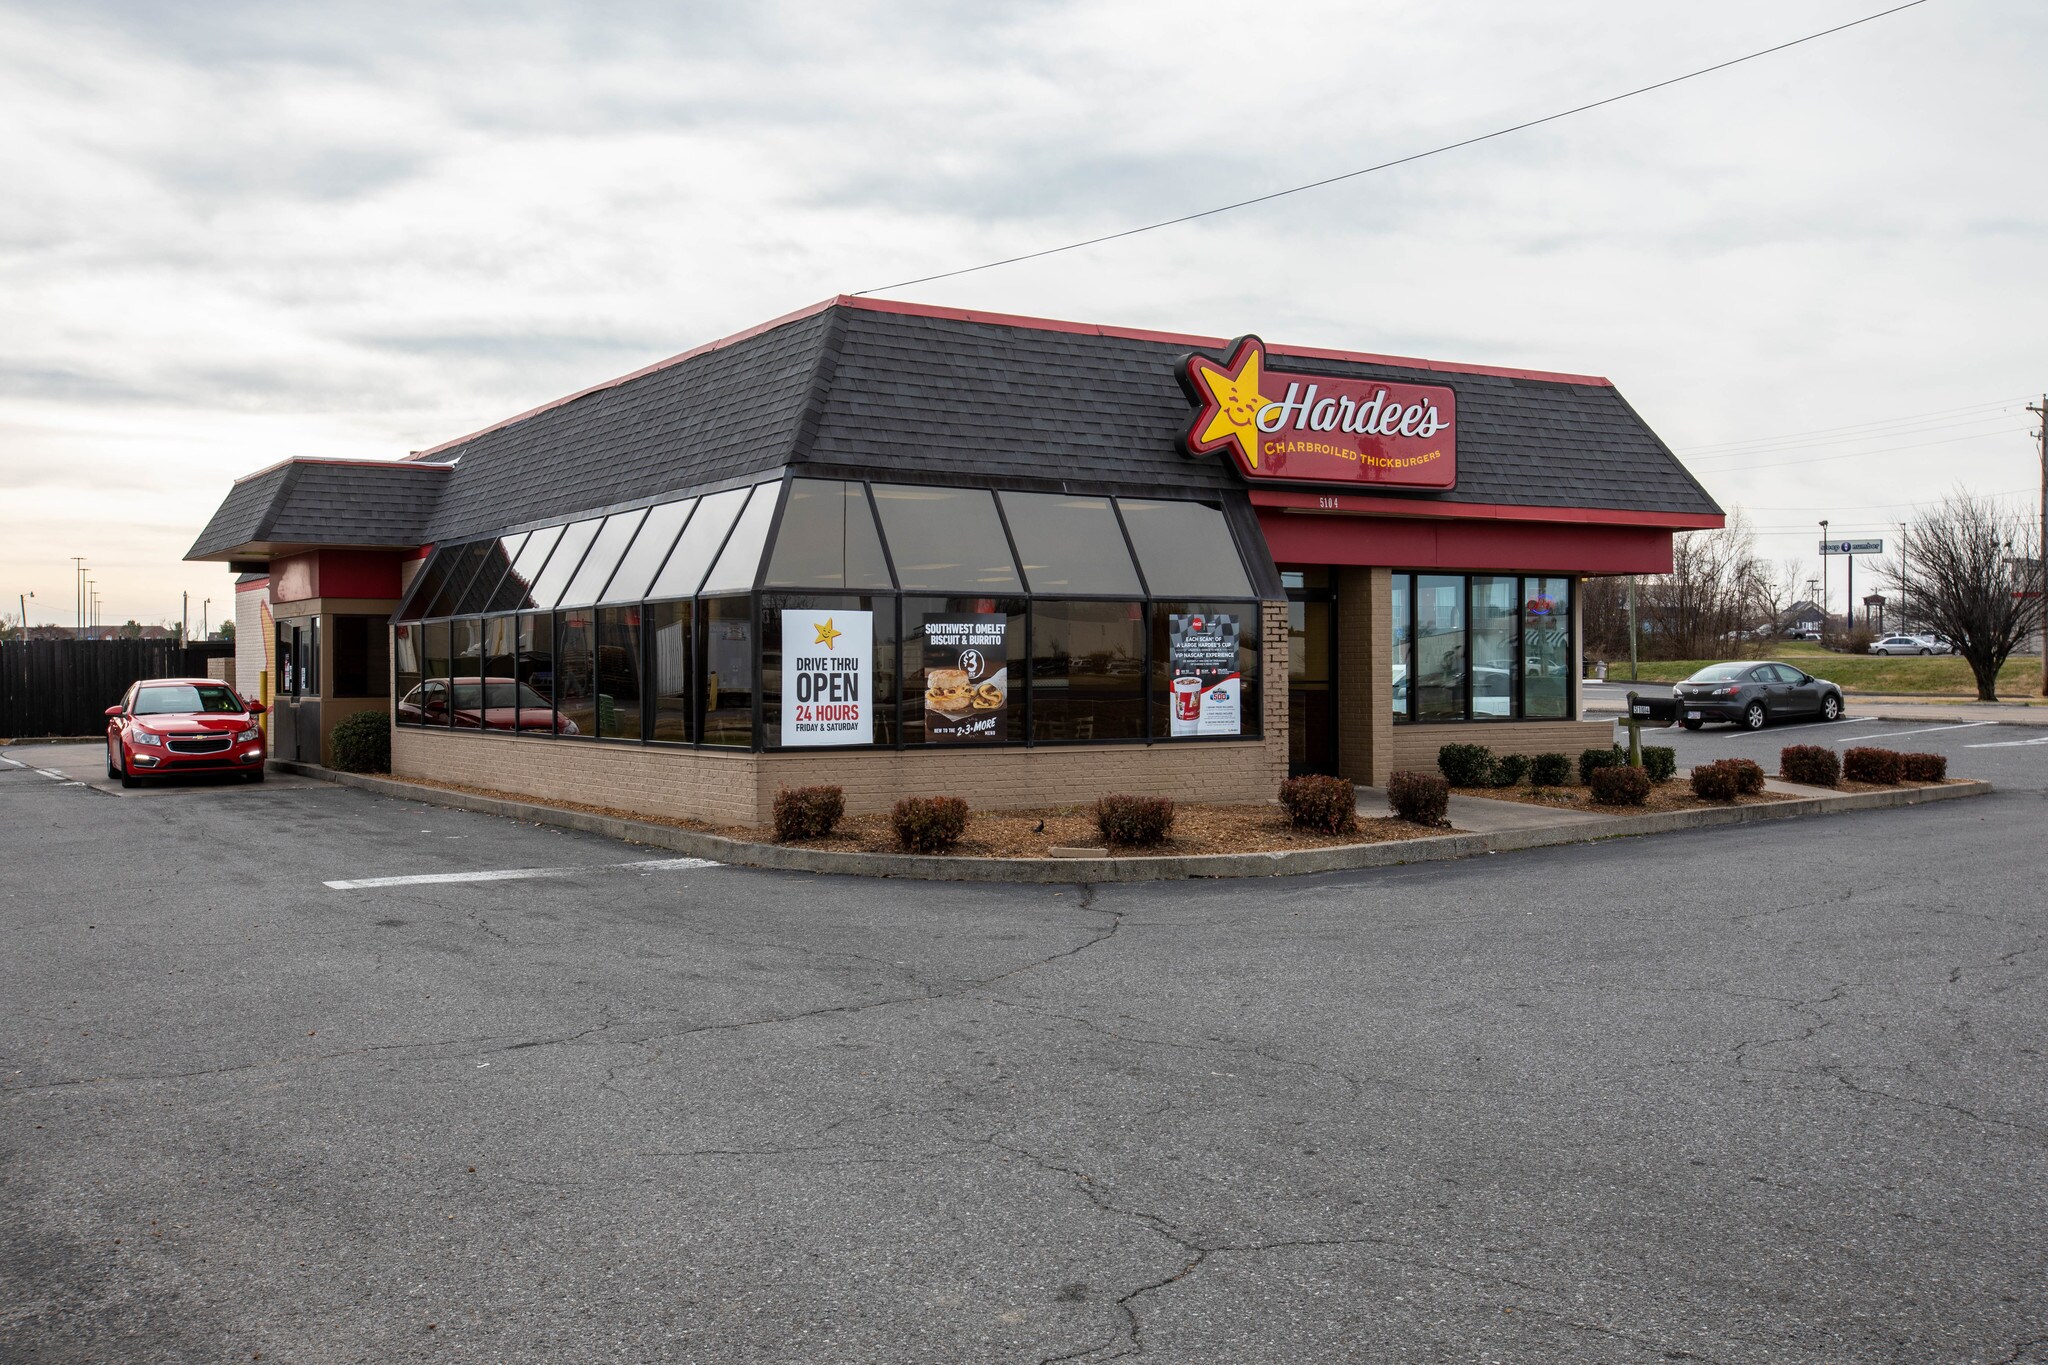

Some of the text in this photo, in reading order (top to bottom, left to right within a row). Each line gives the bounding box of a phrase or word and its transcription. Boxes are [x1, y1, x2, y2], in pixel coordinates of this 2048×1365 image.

[1256, 382, 1450, 438] Hardee's
[1264, 441, 1441, 468] CHARBROILED THICKBURGERS
[1319, 497, 1339, 509] 5104
[925, 623, 1006, 635] SOUTHWEST OMELET
[930, 635, 1001, 646] BISCUIT & BURRITO
[796, 657, 859, 671] DRIVE THRU
[963, 651, 978, 672] $3
[796, 672, 859, 703] OPEN
[795, 704, 859, 722] 24 HOURS
[795, 722, 859, 732] FRIDAY & SATURDAY
